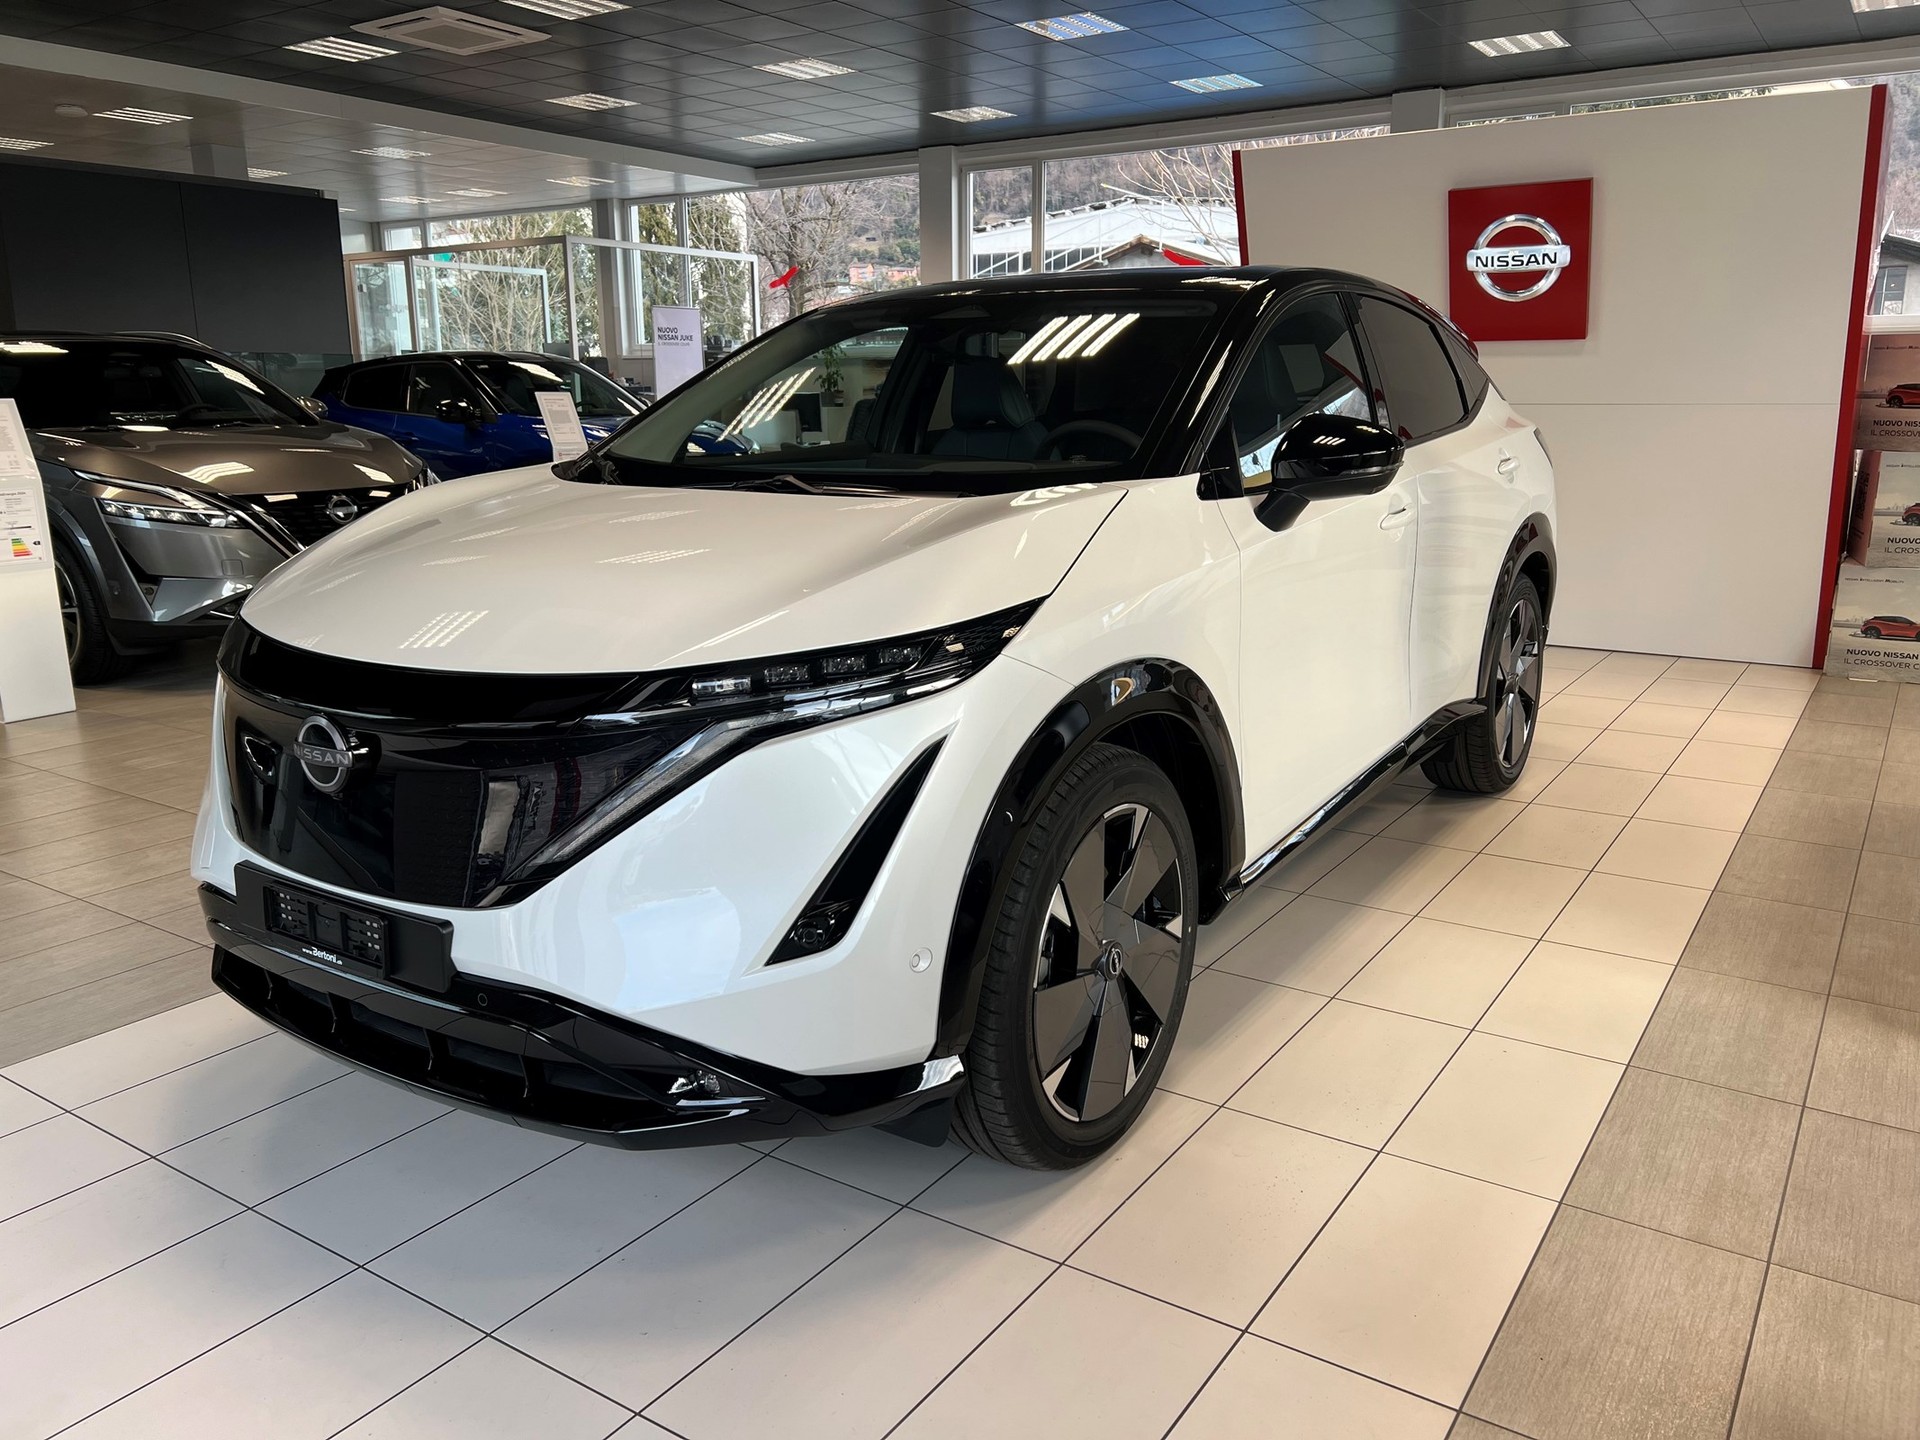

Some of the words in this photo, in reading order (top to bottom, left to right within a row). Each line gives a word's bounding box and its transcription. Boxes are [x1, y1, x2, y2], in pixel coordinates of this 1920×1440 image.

[1475, 252, 1557, 268] NISSAN
[657, 326, 679, 334] NUOVO
[680, 334, 694, 342] JUKE
[1873, 419, 1903, 427] NUOVO
[1894, 546, 1920, 554] CROS
[1846, 648, 1881, 657] NUOVO
[1883, 651, 1919, 660] NISSAN
[1843, 657, 1852, 665] IL
[1853, 658, 1911, 669] CROSSOVER
[293, 743, 349, 765] NISSAN
